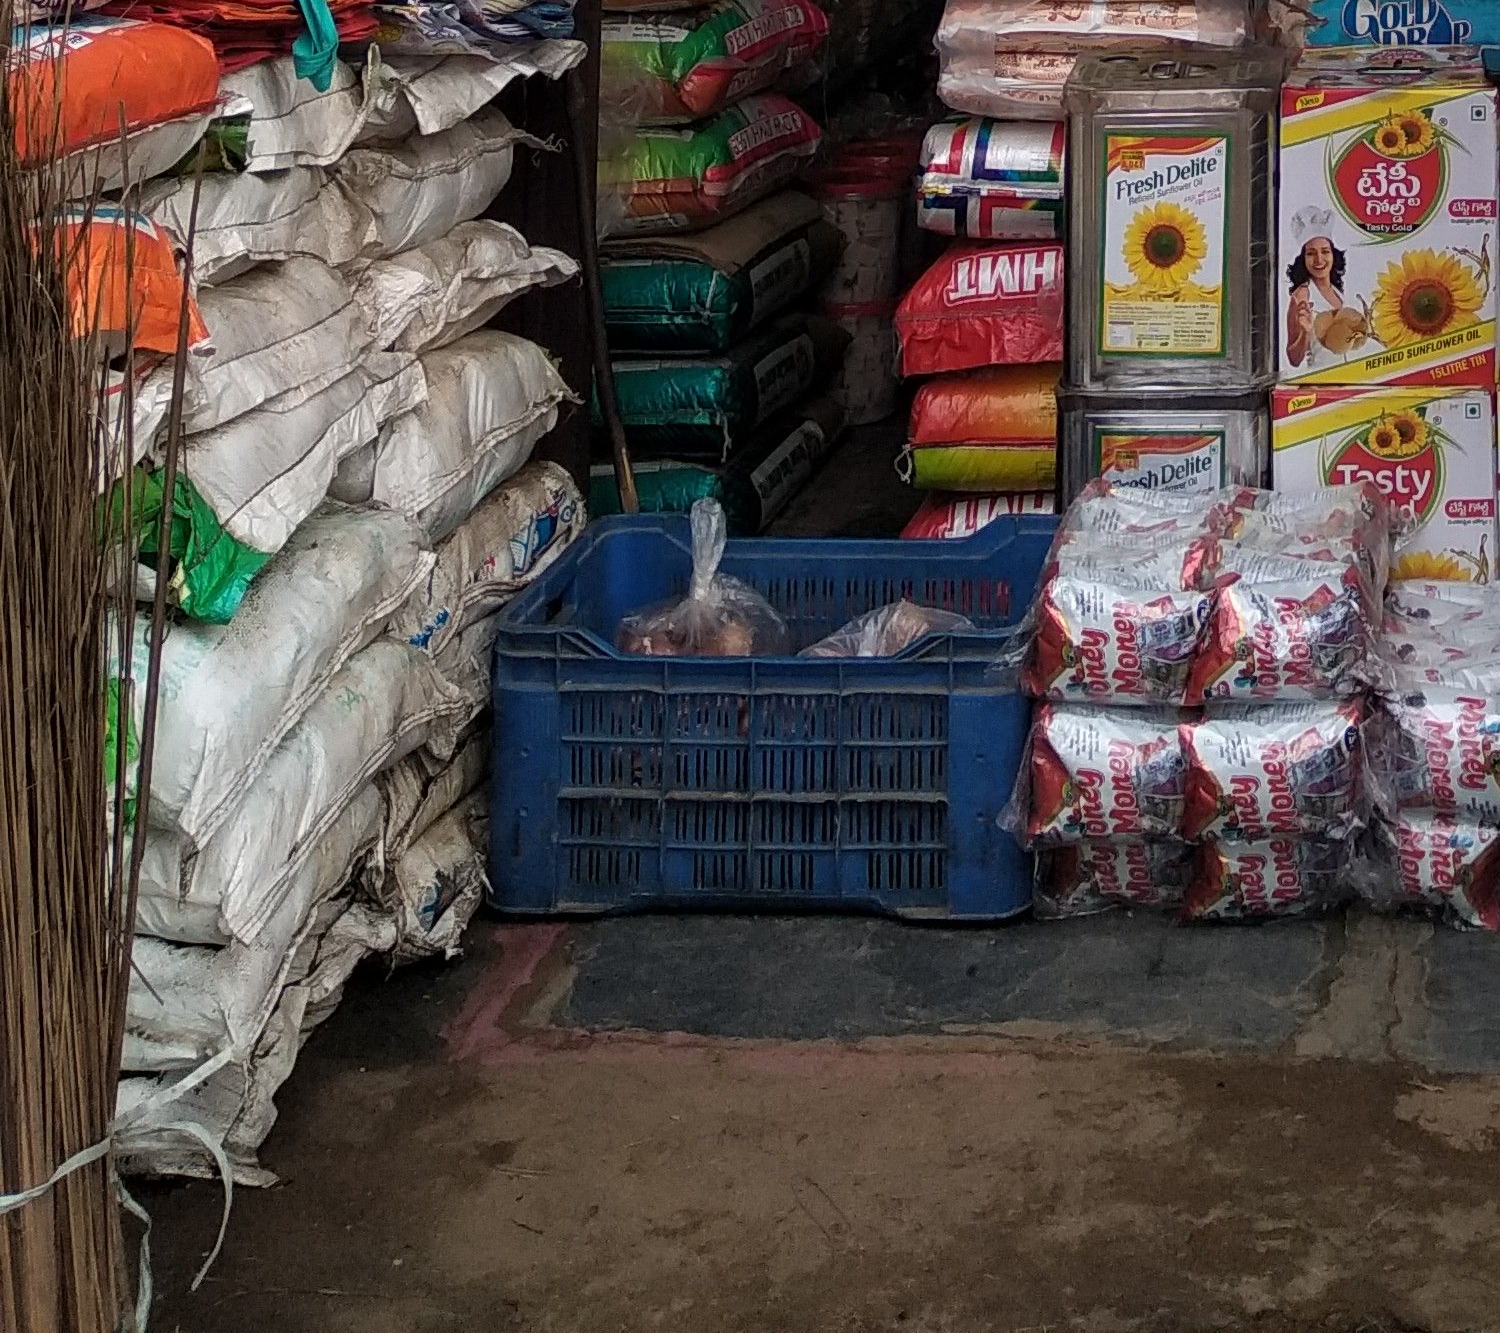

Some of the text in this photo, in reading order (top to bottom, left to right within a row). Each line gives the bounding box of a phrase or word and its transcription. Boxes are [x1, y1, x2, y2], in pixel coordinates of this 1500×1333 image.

[1116, 170, 1164, 201] Fresh
[1166, 156, 1217, 186] Delite
[1357, 161, 1421, 207] టేస్టీ
[950, 250, 1057, 303] HMT
[1364, 328, 1482, 371] REFINED SUNFLOWER OIL
[1470, 353, 1487, 370] TIN
[1159, 454, 1212, 485] Delite
[1335, 463, 1432, 500] Tasty
[1081, 627, 1110, 696] oney
[1112, 600, 1143, 696] Money
[1455, 696, 1488, 791] Money
[1076, 768, 1106, 836] oney
[1107, 738, 1139, 834] Money
[1258, 739, 1297, 834] Money
